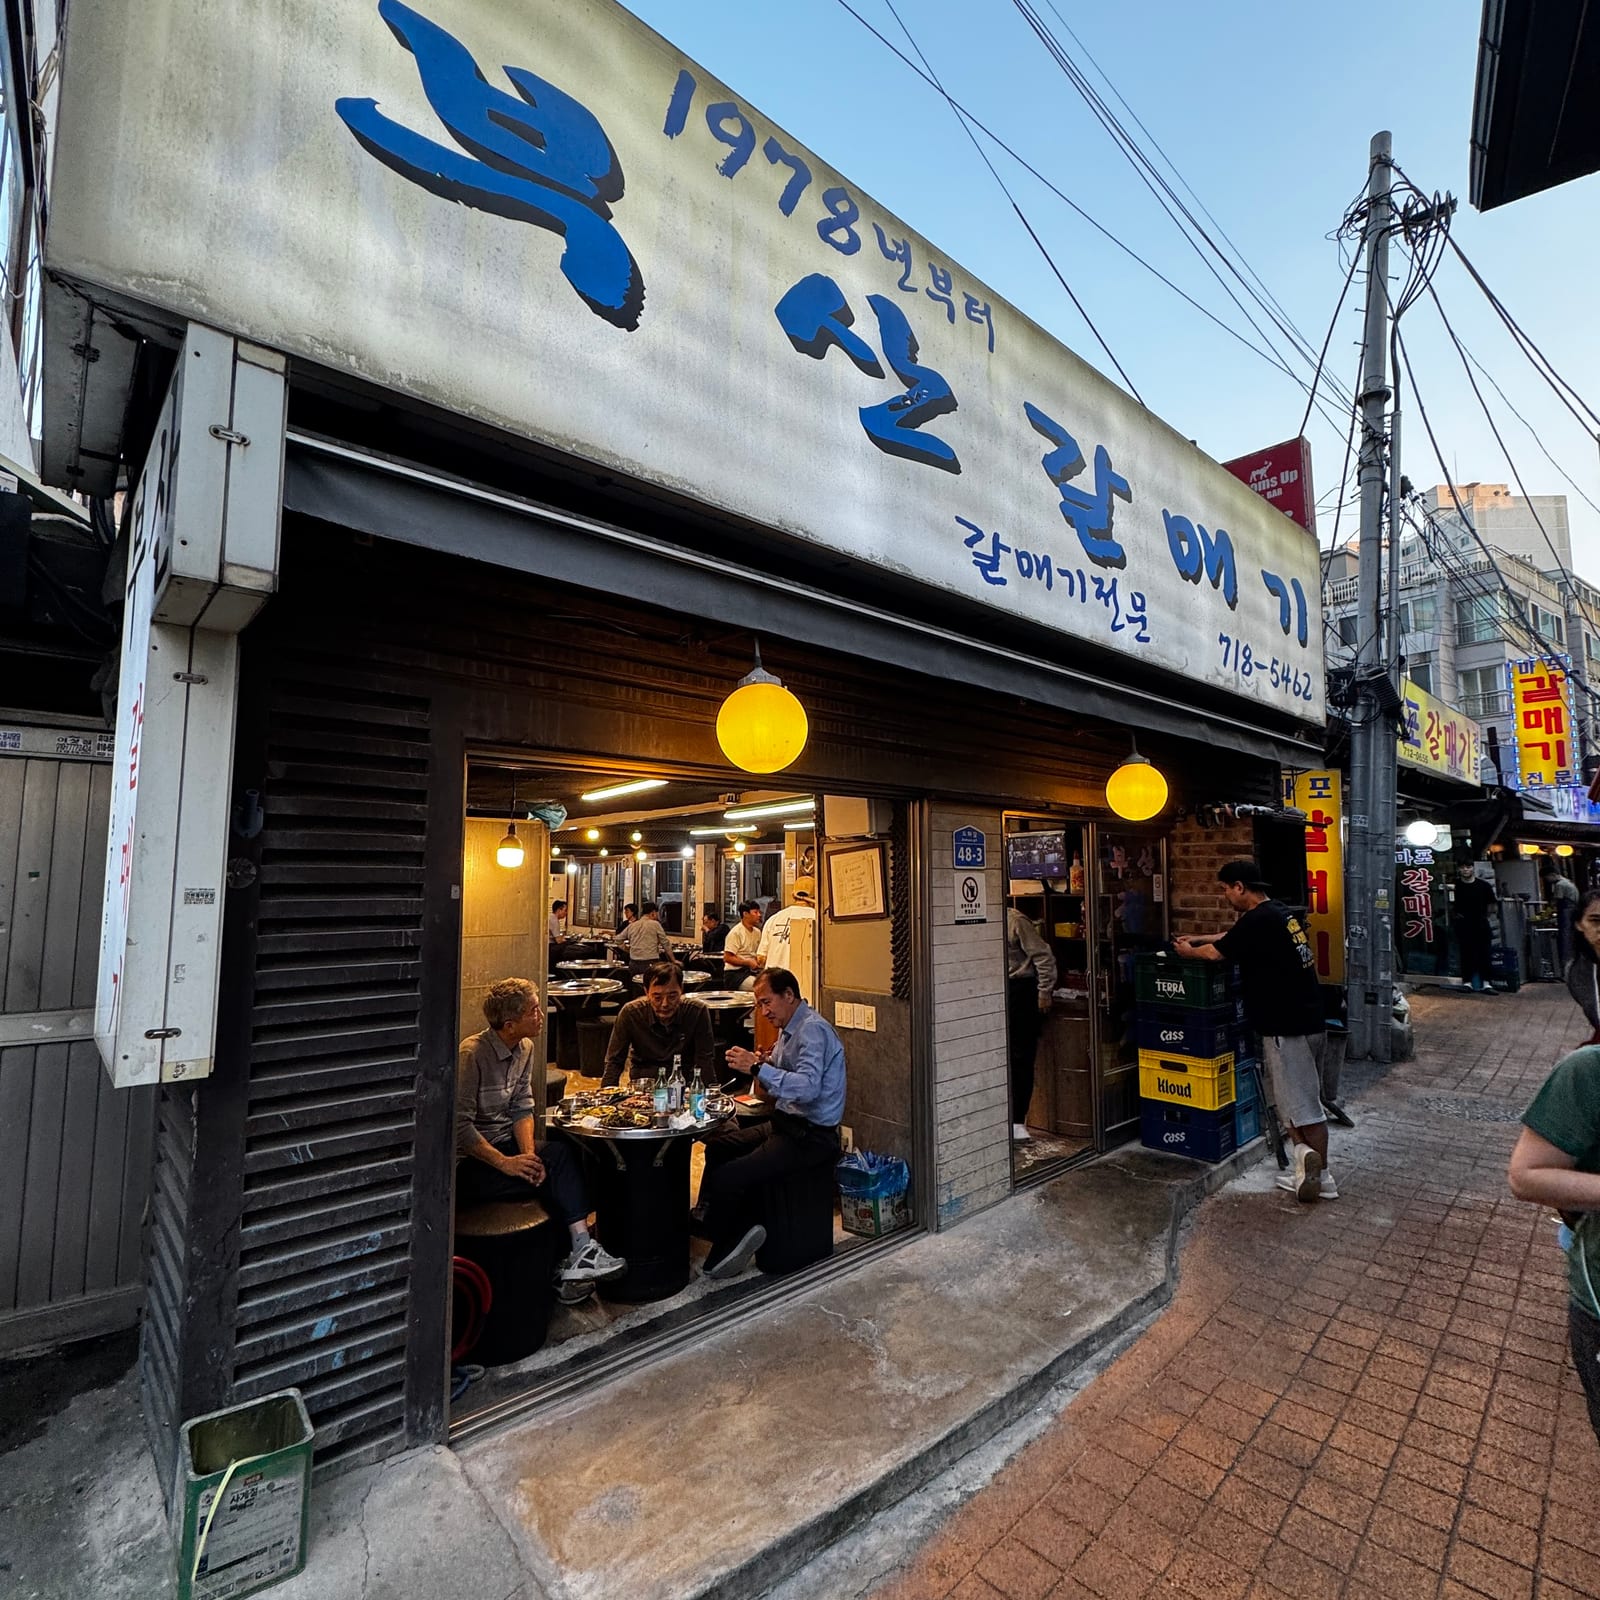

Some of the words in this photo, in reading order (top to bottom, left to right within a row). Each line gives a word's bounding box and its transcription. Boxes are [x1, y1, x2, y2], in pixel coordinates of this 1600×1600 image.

[663, 69, 995, 352] 1978년부터
[1280, 469, 1298, 484] Up
[1219, 631, 1312, 701] 718-5462
[1519, 674, 1566, 768] 갈매기
[1425, 710, 1471, 774] 갈매기
[958, 847, 982, 862] 48-3
[1395, 848, 1435, 866] 마포
[1401, 868, 1434, 942] 갈매기
[1155, 979, 1185, 994] TERRA
[1160, 1030, 1184, 1042] Cass
[1157, 1077, 1192, 1098] Kloud
[1163, 1132, 1186, 1143] Cass
